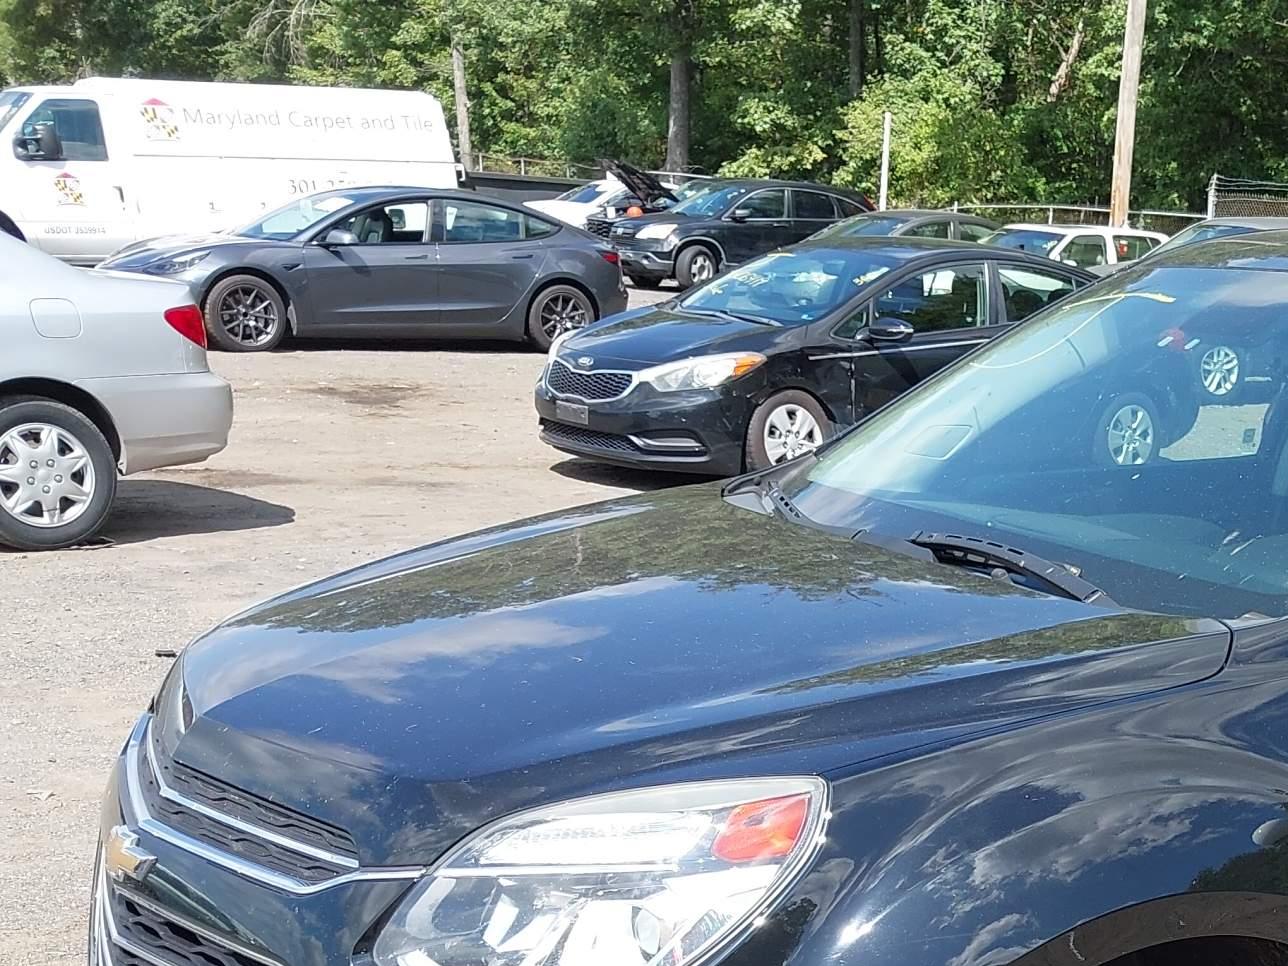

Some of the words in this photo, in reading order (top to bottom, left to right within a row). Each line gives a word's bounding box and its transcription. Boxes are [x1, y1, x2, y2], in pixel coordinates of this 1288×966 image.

[182, 107, 281, 129] Maryland
[287, 110, 353, 132] Carpet
[360, 115, 396, 130] and
[401, 114, 434, 133] Tile
